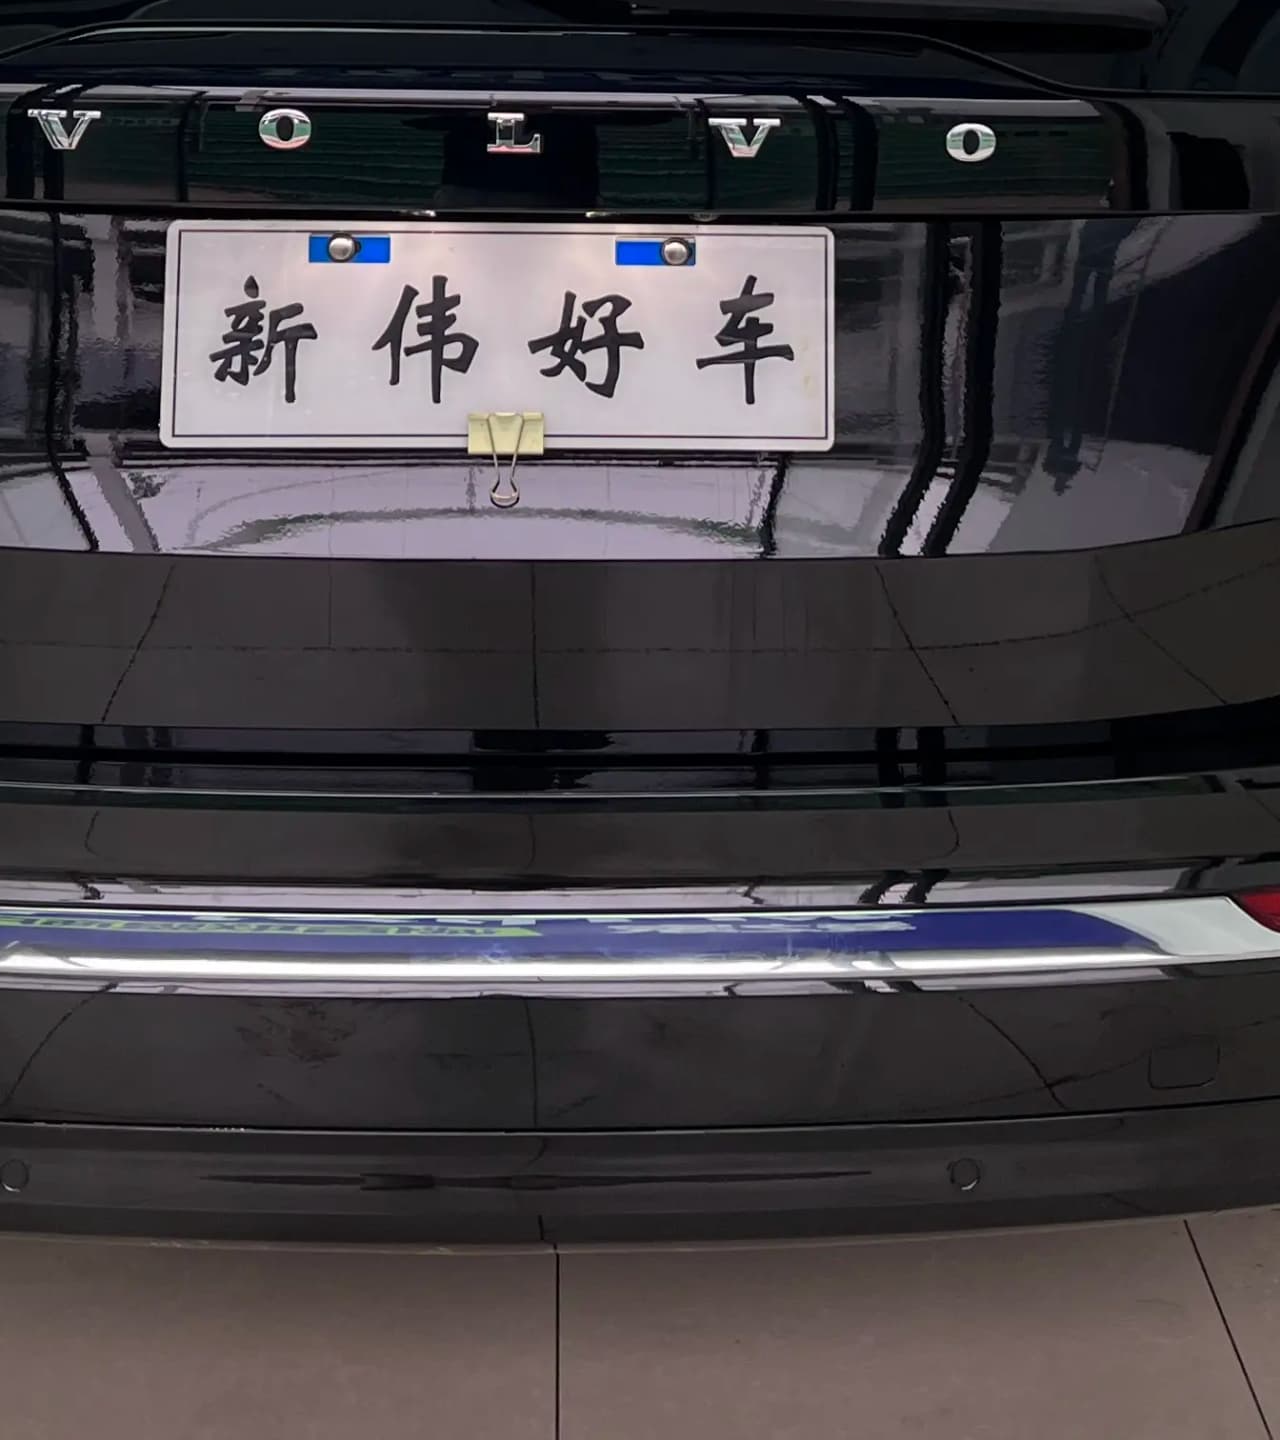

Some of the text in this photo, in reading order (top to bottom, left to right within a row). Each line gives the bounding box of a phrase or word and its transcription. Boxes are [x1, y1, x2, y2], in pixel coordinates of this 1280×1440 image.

[28, 108, 997, 163] VOLVO
[208, 274, 795, 405] 新伟好车
